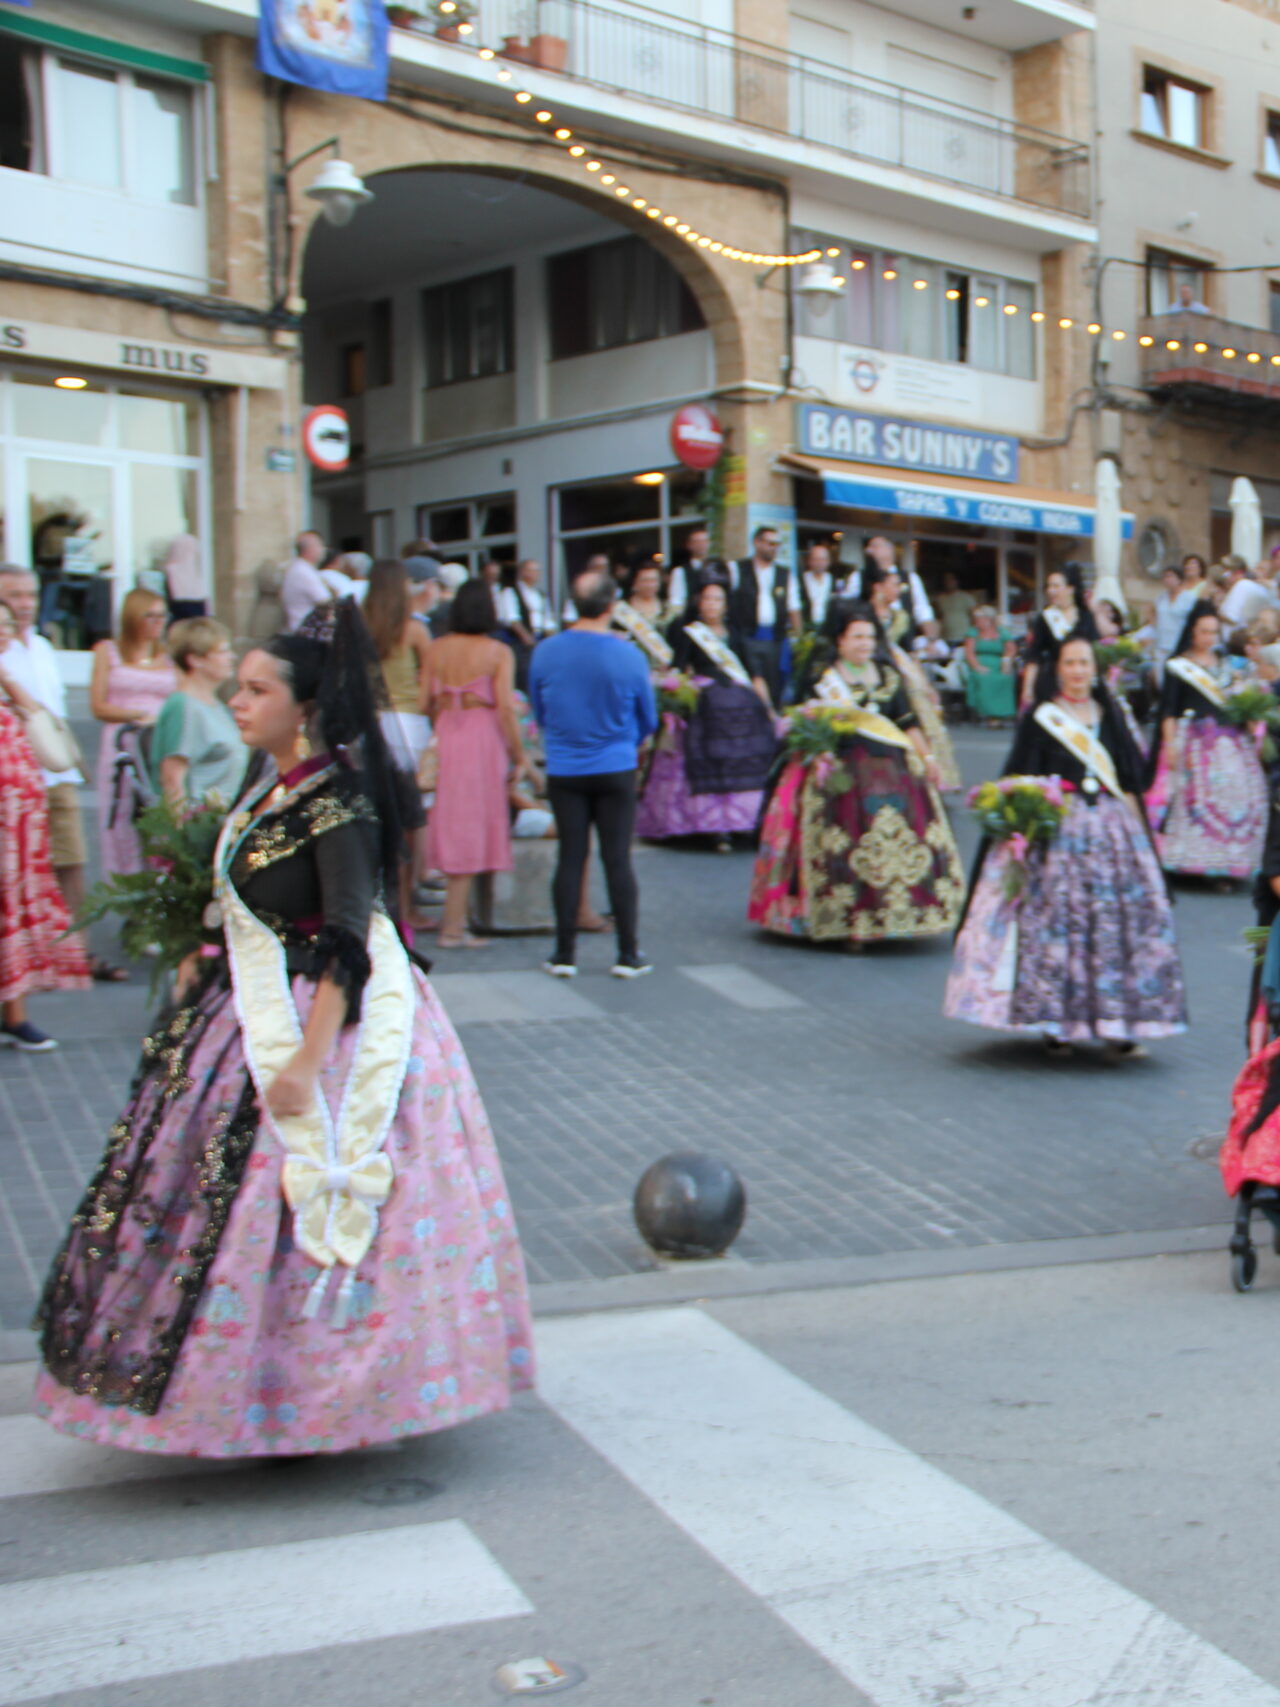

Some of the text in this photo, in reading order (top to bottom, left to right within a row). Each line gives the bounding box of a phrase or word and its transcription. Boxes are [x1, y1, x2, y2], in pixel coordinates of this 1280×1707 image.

[121, 343, 208, 374] mus
[809, 411, 1012, 476] BAR SUNNY'S
